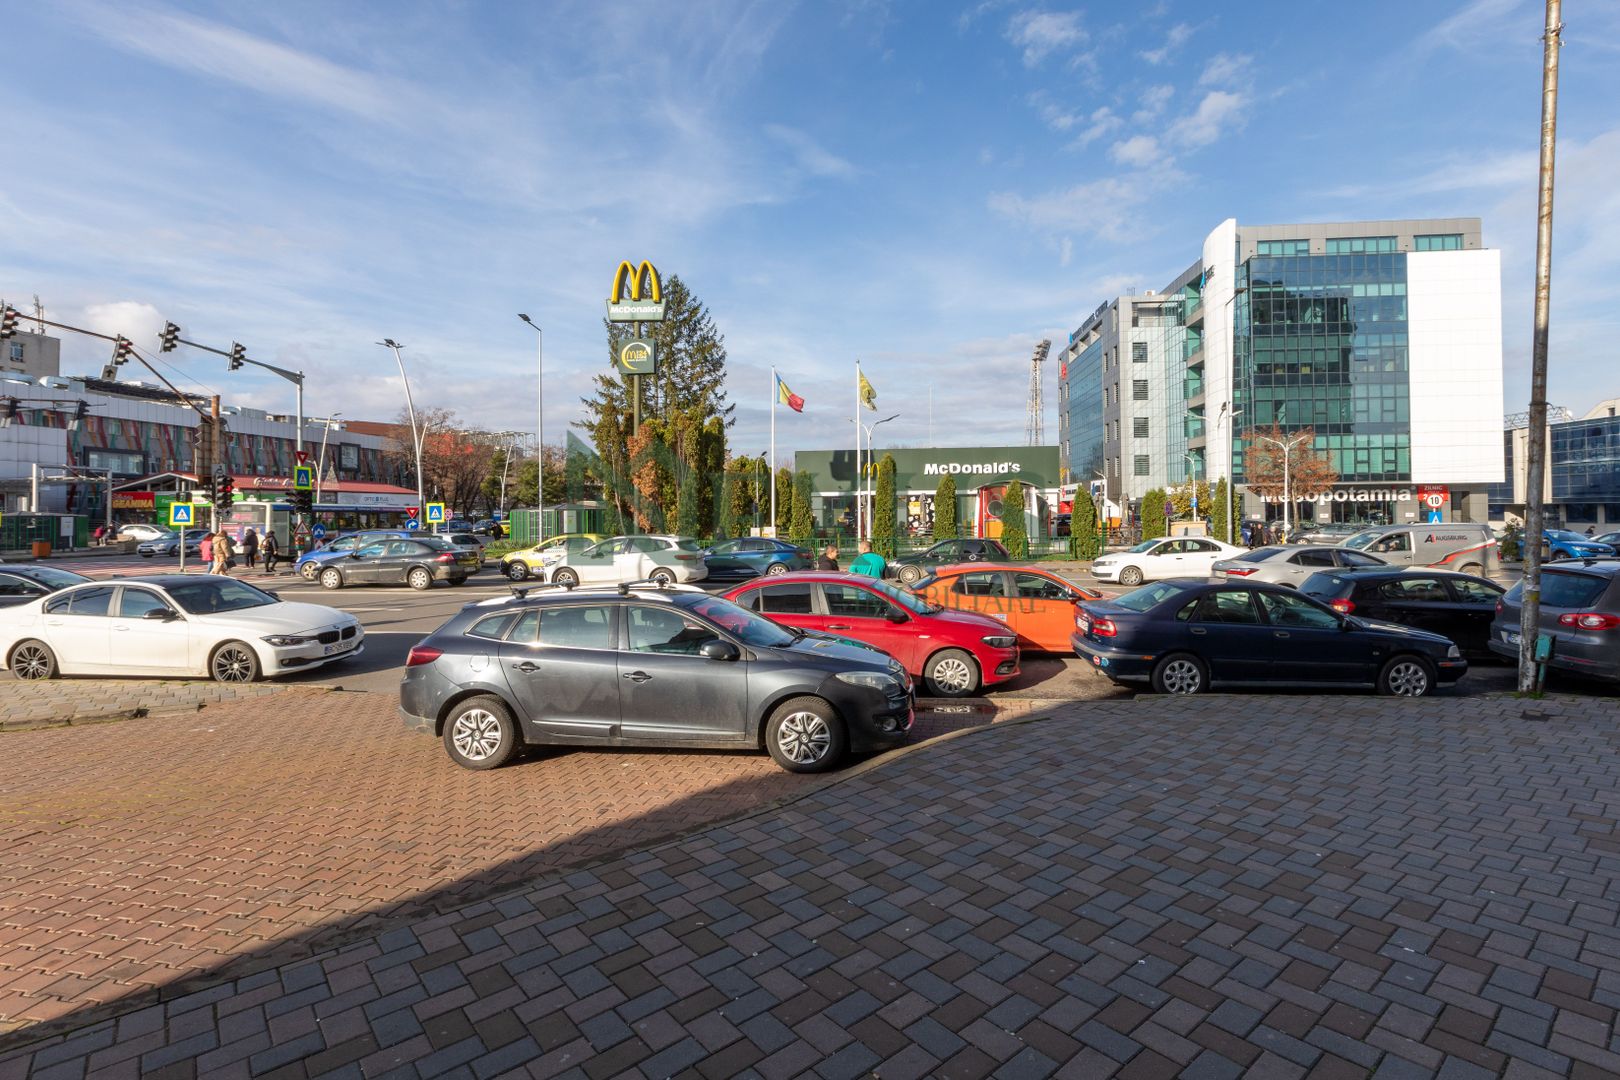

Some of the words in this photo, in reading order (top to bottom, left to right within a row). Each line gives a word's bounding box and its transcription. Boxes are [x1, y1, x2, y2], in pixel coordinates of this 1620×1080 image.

[610, 306, 662, 314] McDonald's
[923, 461, 1021, 476] McDonald's
[1430, 496, 1440, 505] 10
